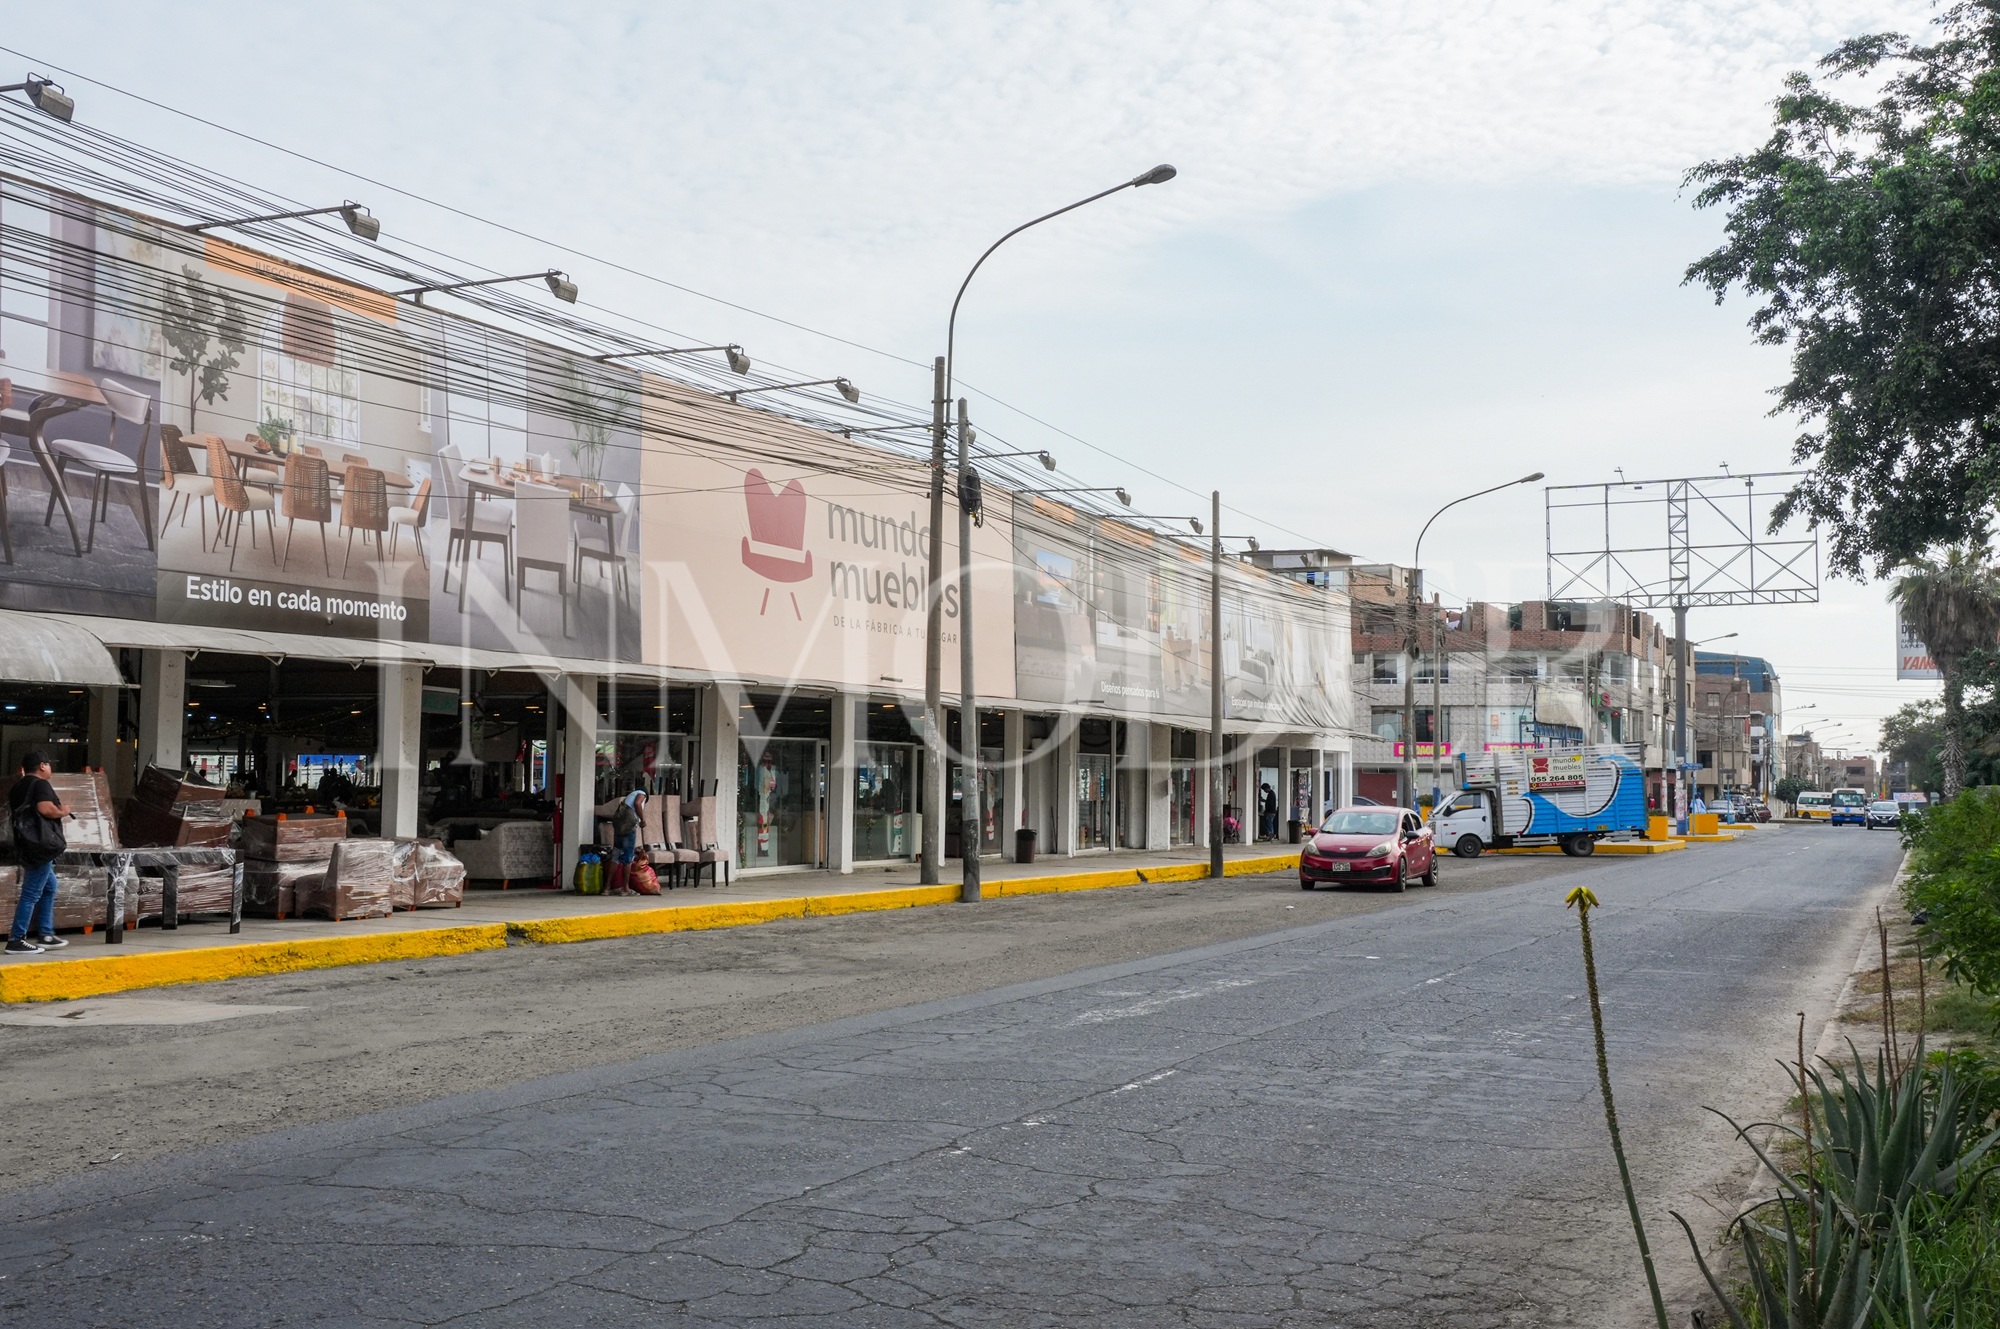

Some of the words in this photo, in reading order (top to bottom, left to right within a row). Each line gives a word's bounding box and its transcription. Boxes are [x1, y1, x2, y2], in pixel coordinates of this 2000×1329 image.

[255, 261, 292, 283] JUEGOS
[186, 575, 243, 604] Estilo
[248, 589, 272, 607] en
[277, 589, 321, 613] cada
[326, 597, 407, 622] momento
[830, 560, 959, 619] muebls
[833, 615, 845, 628] DE
[850, 619, 861, 629] LA
[866, 619, 903, 636] FÁBRICA
[907, 628, 912, 638] A
[916, 628, 926, 640] TU
[1101, 681, 1121, 695] Diseños
[1121, 685, 1145, 698] pensados
[1145, 688, 1155, 699] para
[1553, 763, 1581, 771] muebles
